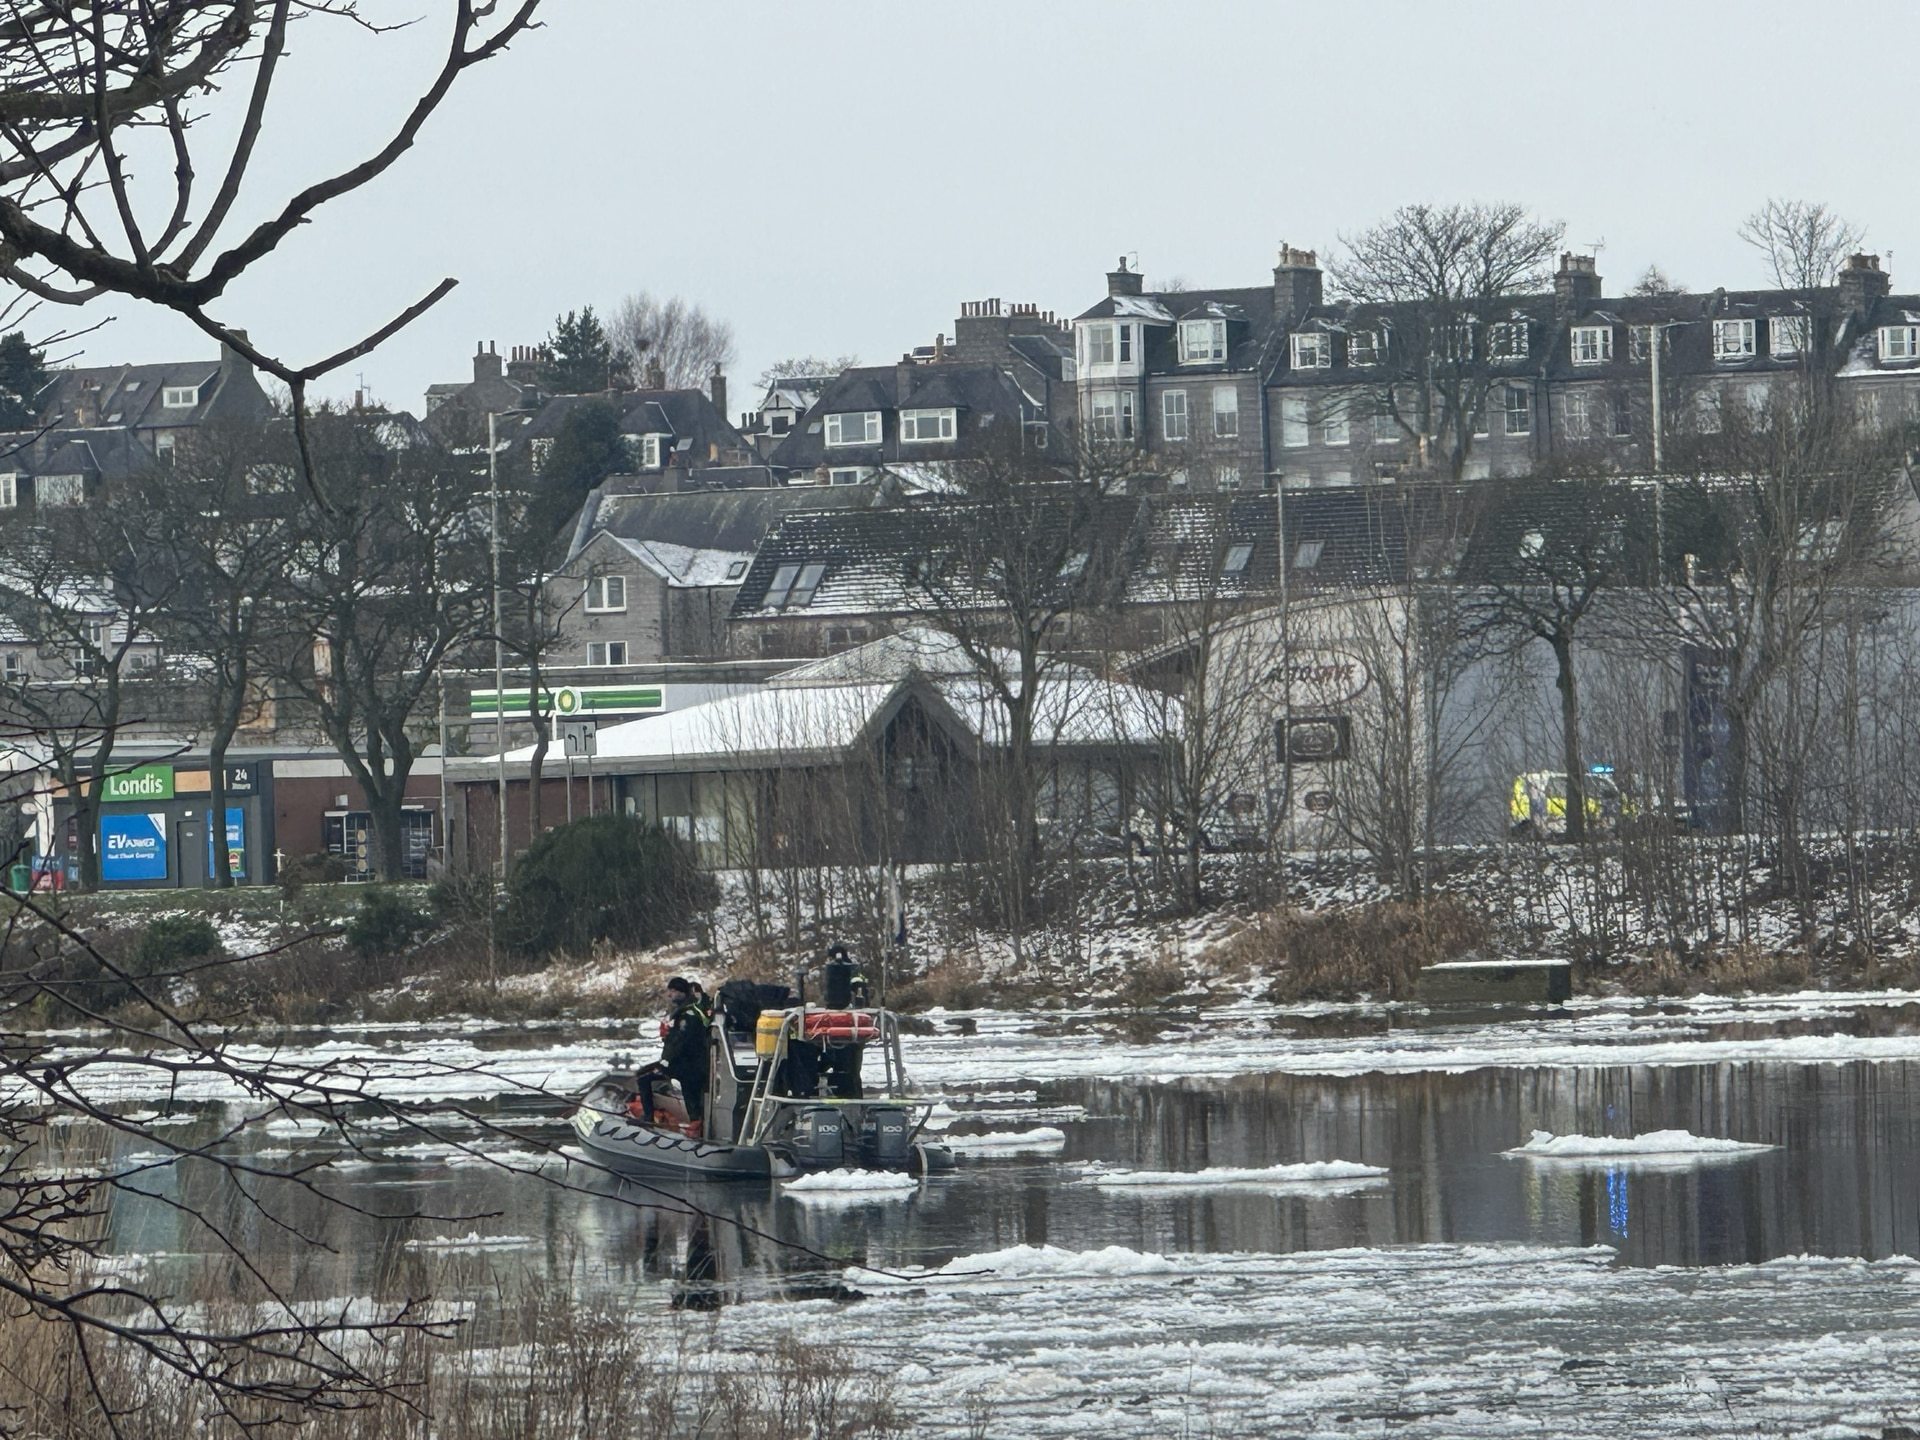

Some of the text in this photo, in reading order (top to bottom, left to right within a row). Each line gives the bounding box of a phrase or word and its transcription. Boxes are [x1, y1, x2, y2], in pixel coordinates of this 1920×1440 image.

[235, 768, 247, 781] 24
[110, 774, 163, 795] Londis
[818, 1124, 839, 1133] 100
[883, 1125, 903, 1133] 100
